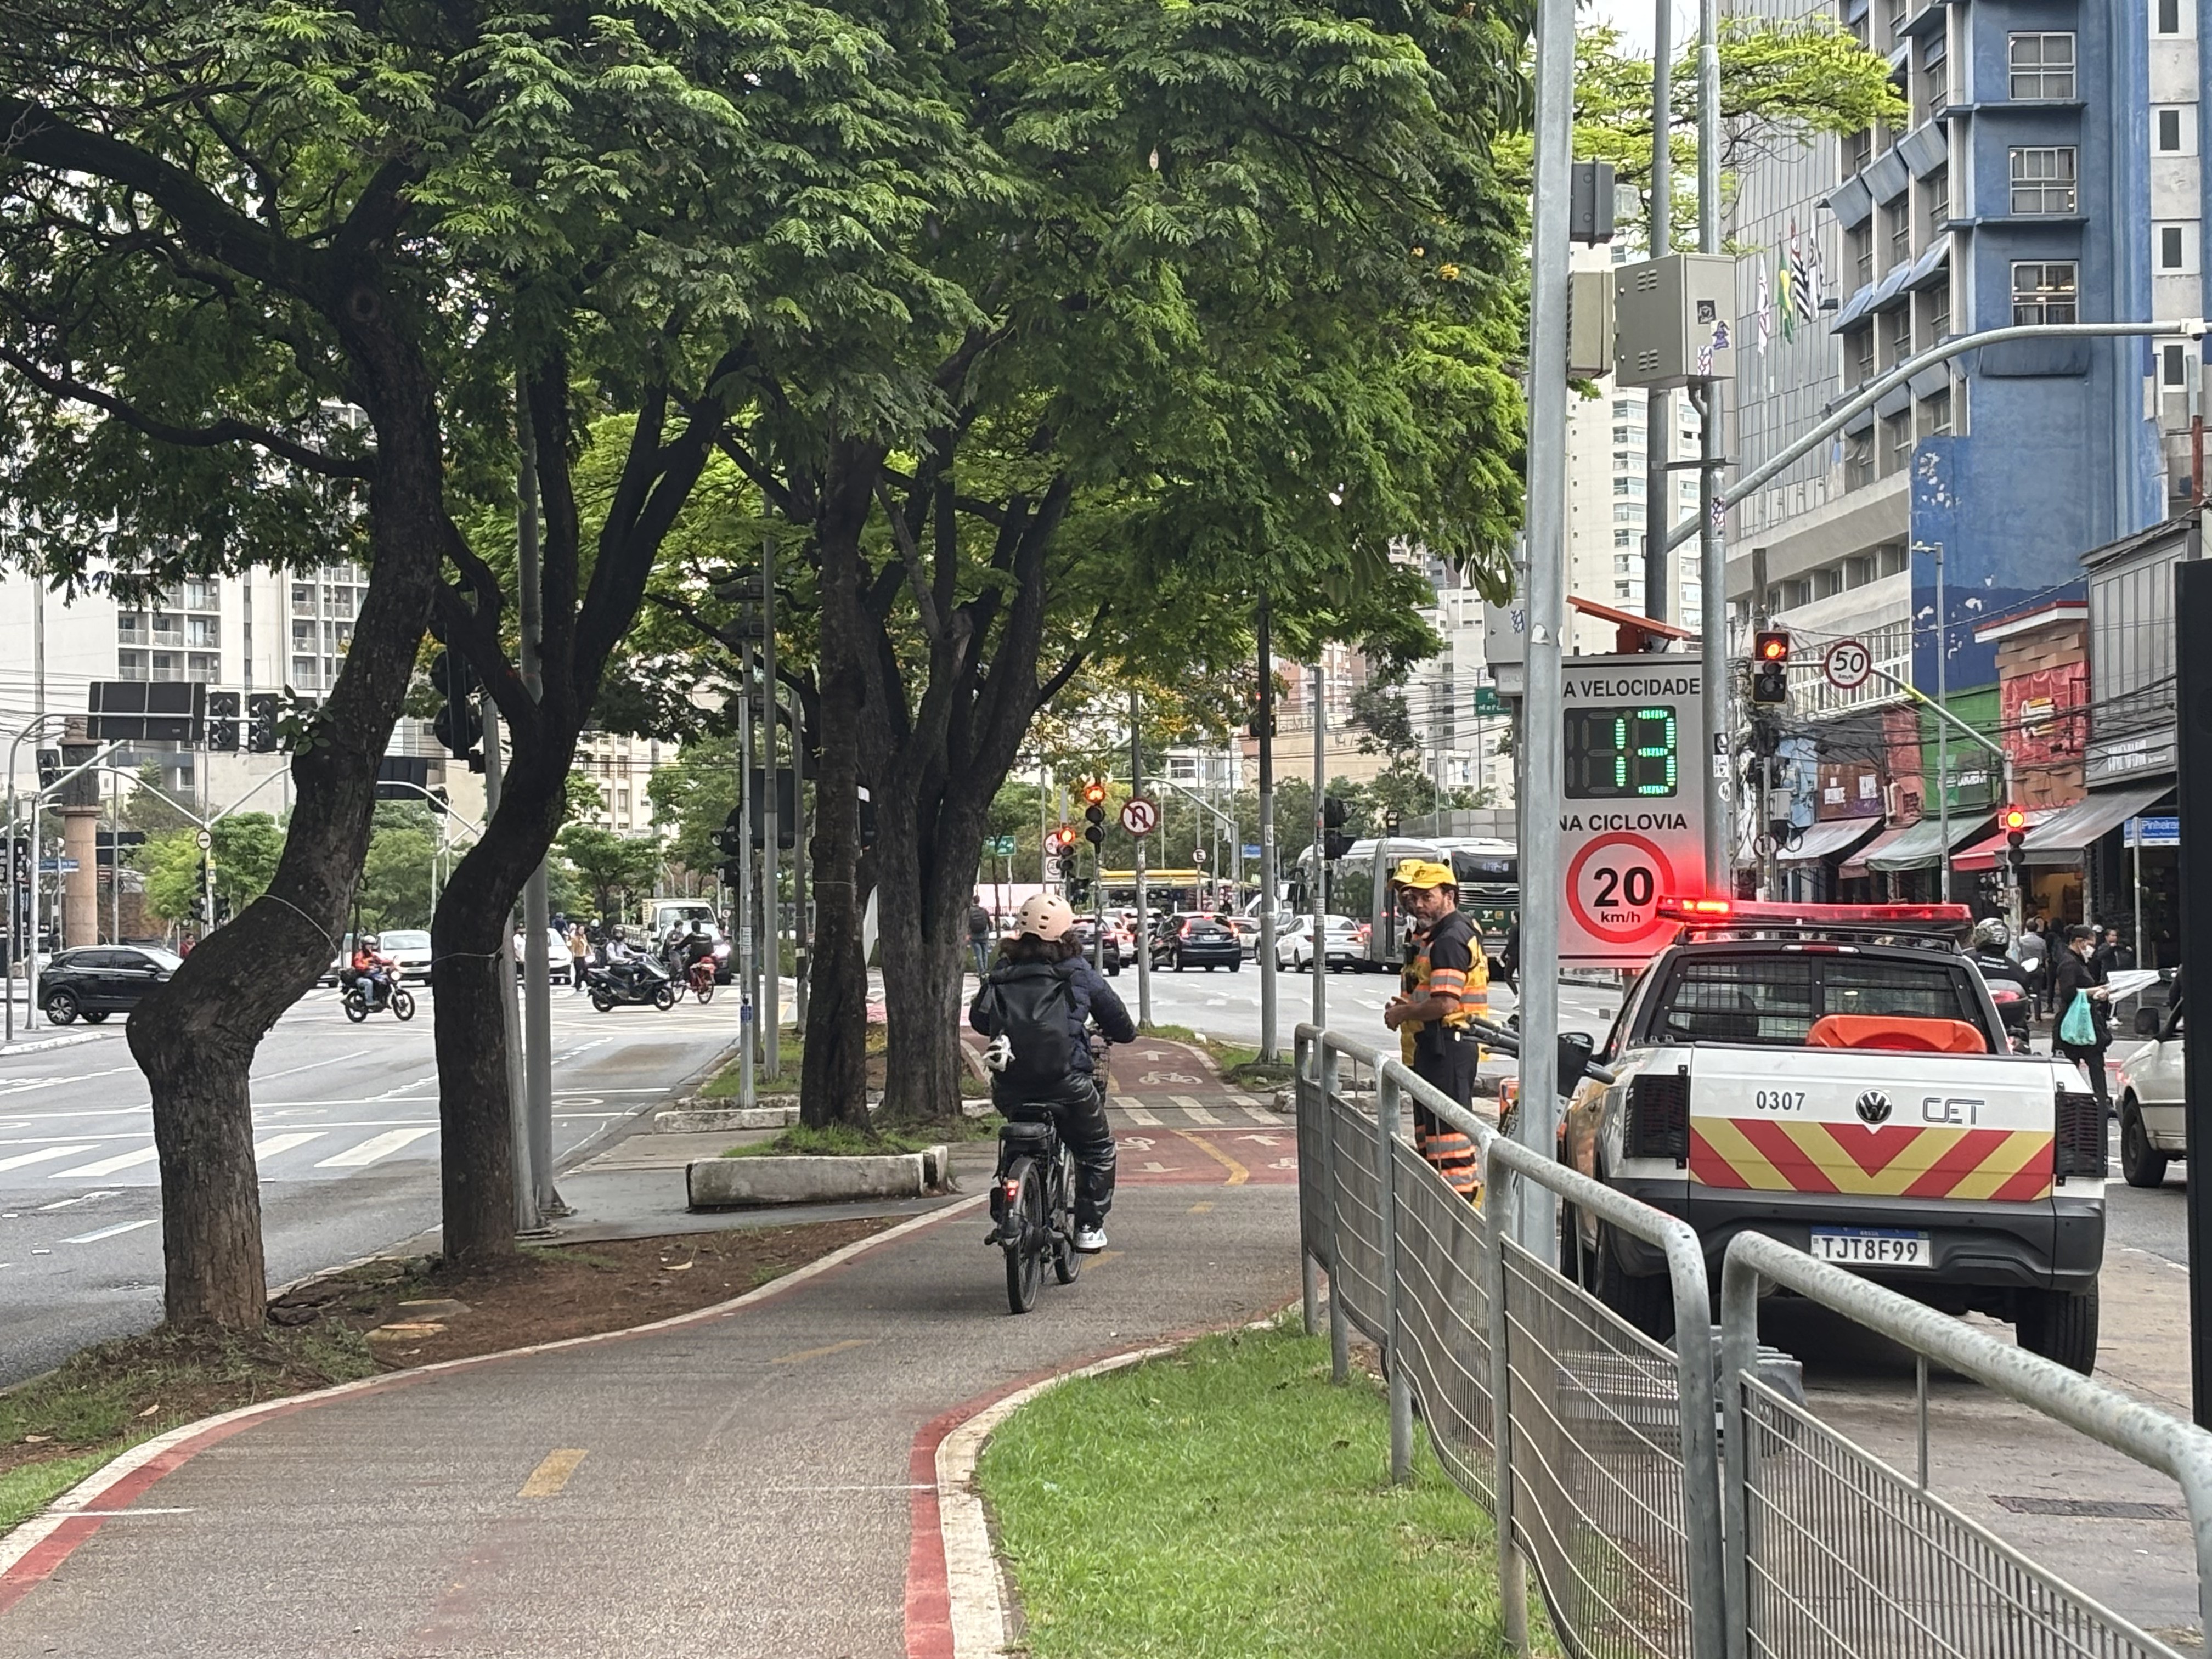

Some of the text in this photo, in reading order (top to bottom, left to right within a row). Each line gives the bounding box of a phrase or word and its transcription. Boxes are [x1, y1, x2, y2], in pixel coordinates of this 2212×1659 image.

[1833, 651, 1864, 673] 50
[1563, 678, 1701, 698] A VELOCIDADE
[1615, 710, 1676, 795] 13
[1589, 812, 1688, 831] CICLOVIA
[1593, 867, 1654, 907] 20
[1600, 910, 1641, 923] km/h
[1756, 1090, 1806, 1111] 0307
[1922, 1097, 1985, 1125] CET
[1821, 1237, 1918, 1262] TJT8F99
